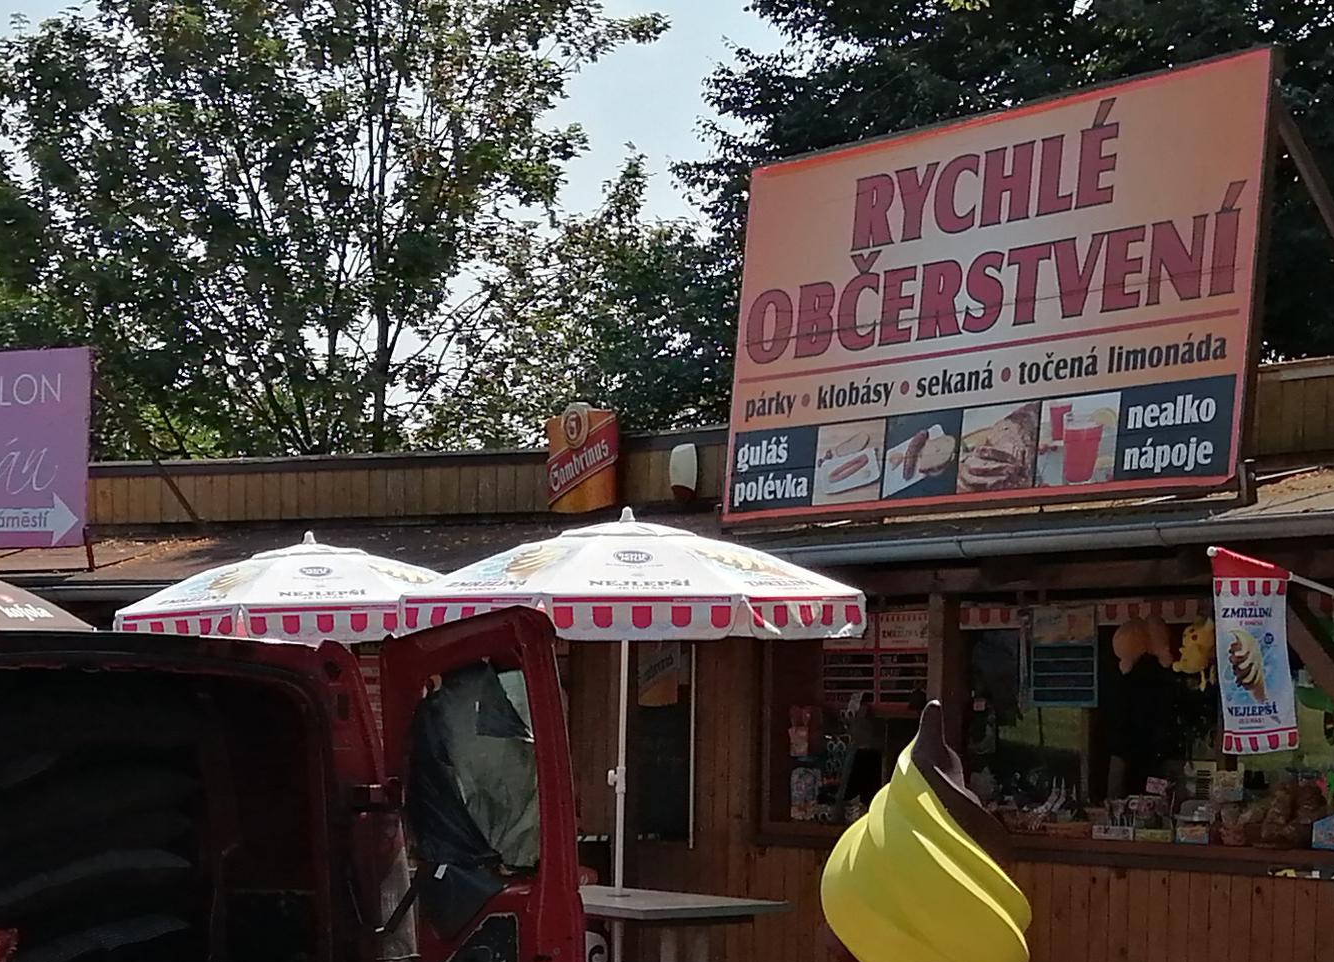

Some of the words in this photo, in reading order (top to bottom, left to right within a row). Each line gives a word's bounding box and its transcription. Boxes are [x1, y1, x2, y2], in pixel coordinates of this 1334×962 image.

[851, 97, 1120, 252] RYCHLÉ
[745, 179, 1247, 365] OBČERSTVENÍ
[745, 390, 797, 422] párky
[817, 377, 895, 410] klobásy
[916, 360, 993, 398] sekaná
[1019, 351, 1098, 385] točená
[1107, 333, 1227, 374] limonáda
[1126, 393, 1216, 430] nealko
[550, 440, 609, 492] Gambrinus
[736, 436, 788, 473] guláš
[1123, 437, 1213, 473] nápoje
[733, 468, 808, 506] polévka
